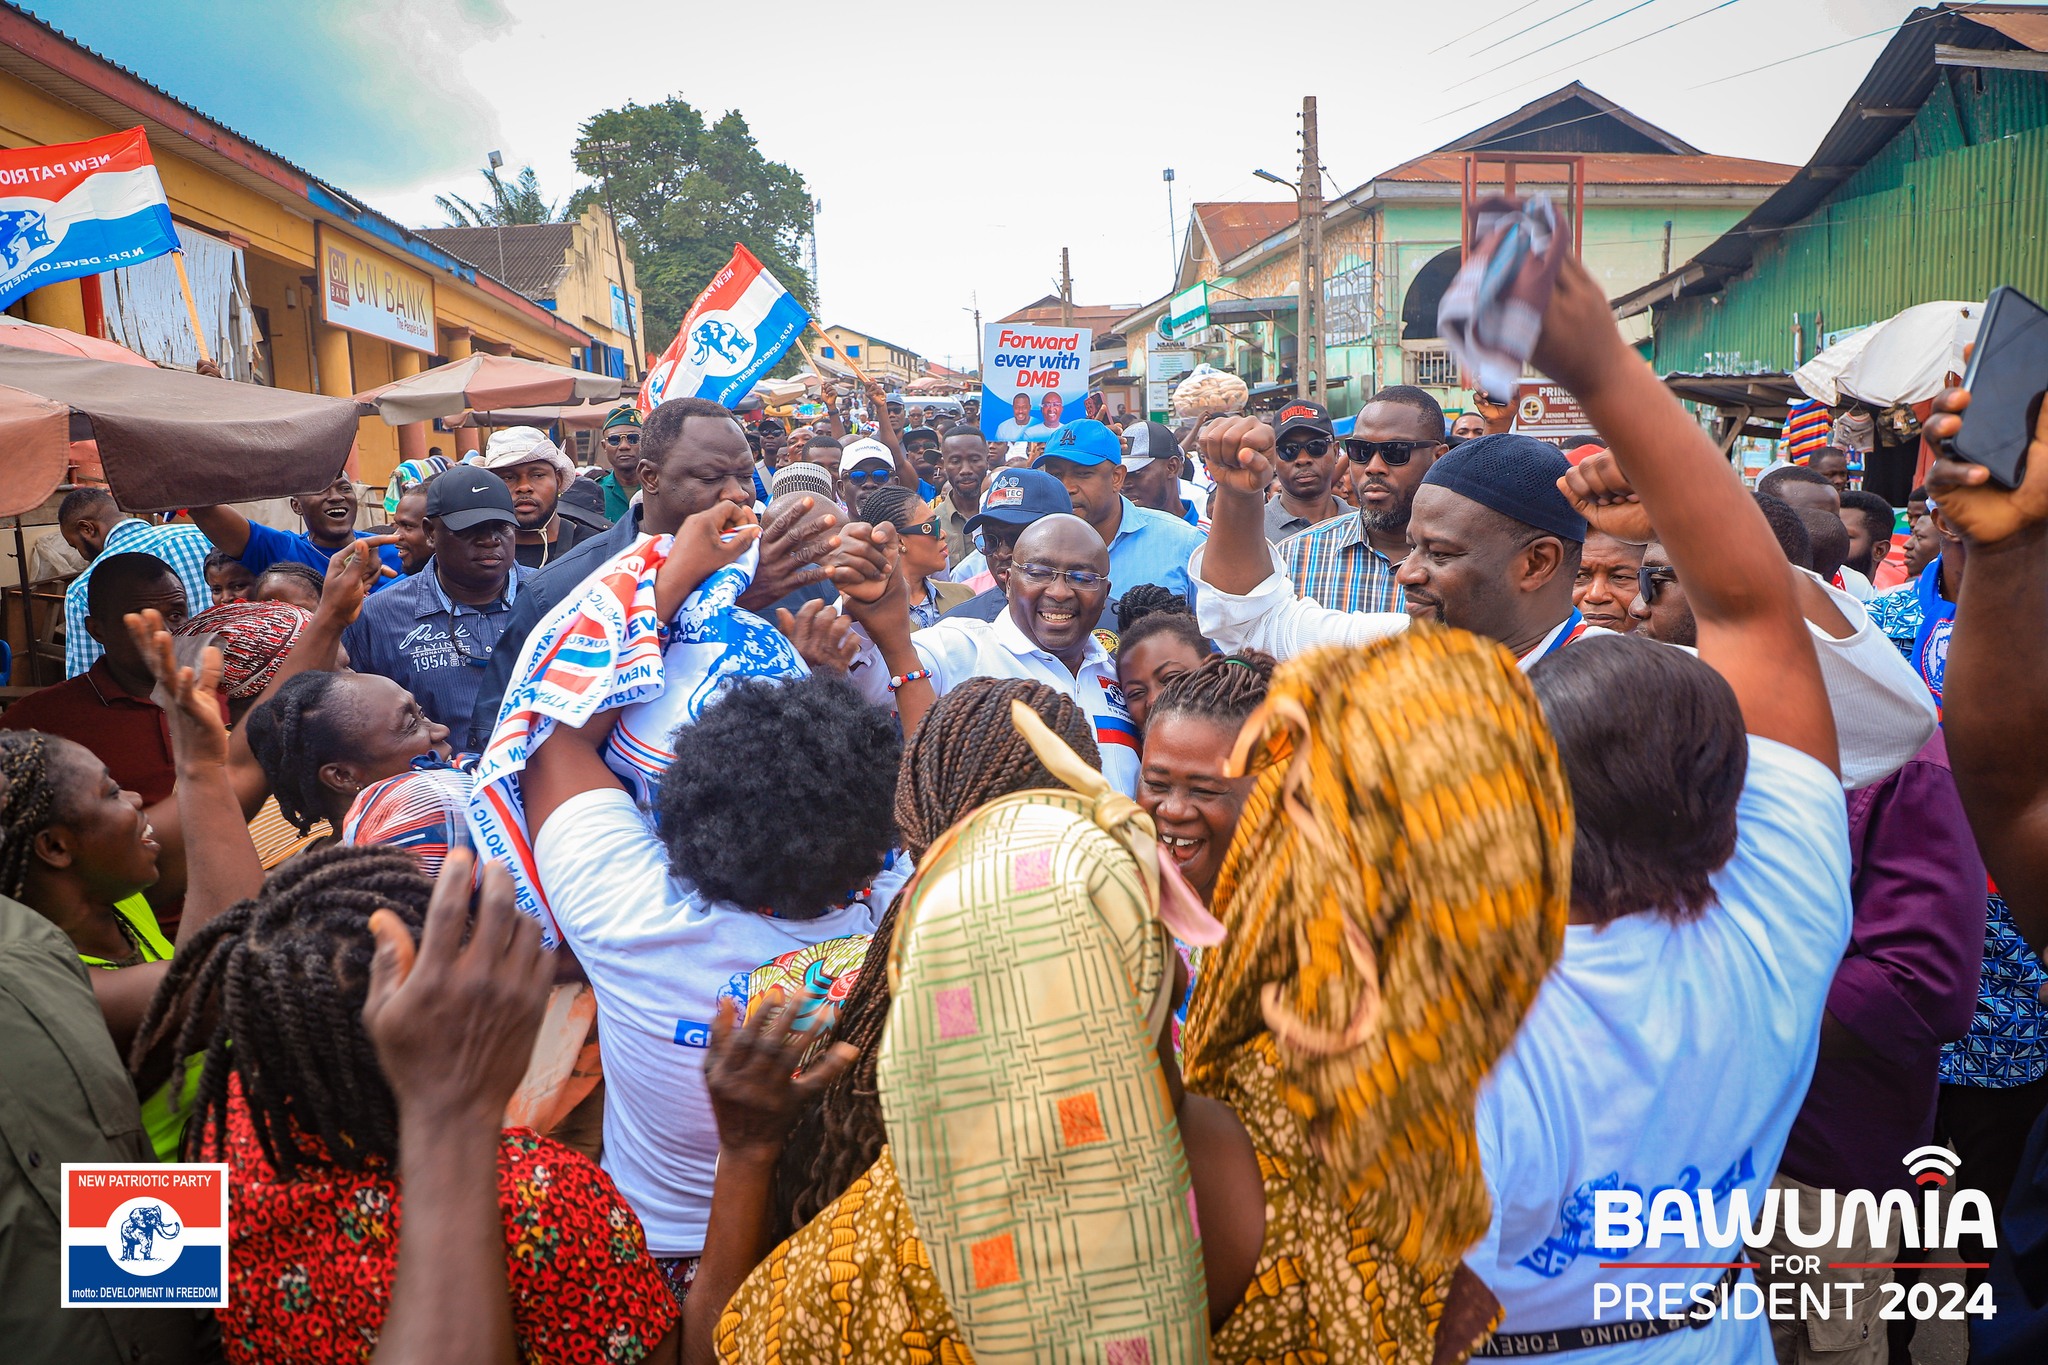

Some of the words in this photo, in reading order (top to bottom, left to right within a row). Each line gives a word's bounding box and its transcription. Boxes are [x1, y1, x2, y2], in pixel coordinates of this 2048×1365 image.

[330, 252, 347, 284] GN
[331, 285, 349, 301] BANK
[354, 257, 379, 309] GN
[384, 271, 427, 326] BANK
[998, 330, 1079, 351] Forward
[994, 353, 1036, 368] ever
[1039, 351, 1080, 370] with
[1016, 370, 1061, 388] DMB
[399, 623, 471, 650] Peak
[413, 653, 448, 673] 1954
[617, 664, 651, 686] NEW
